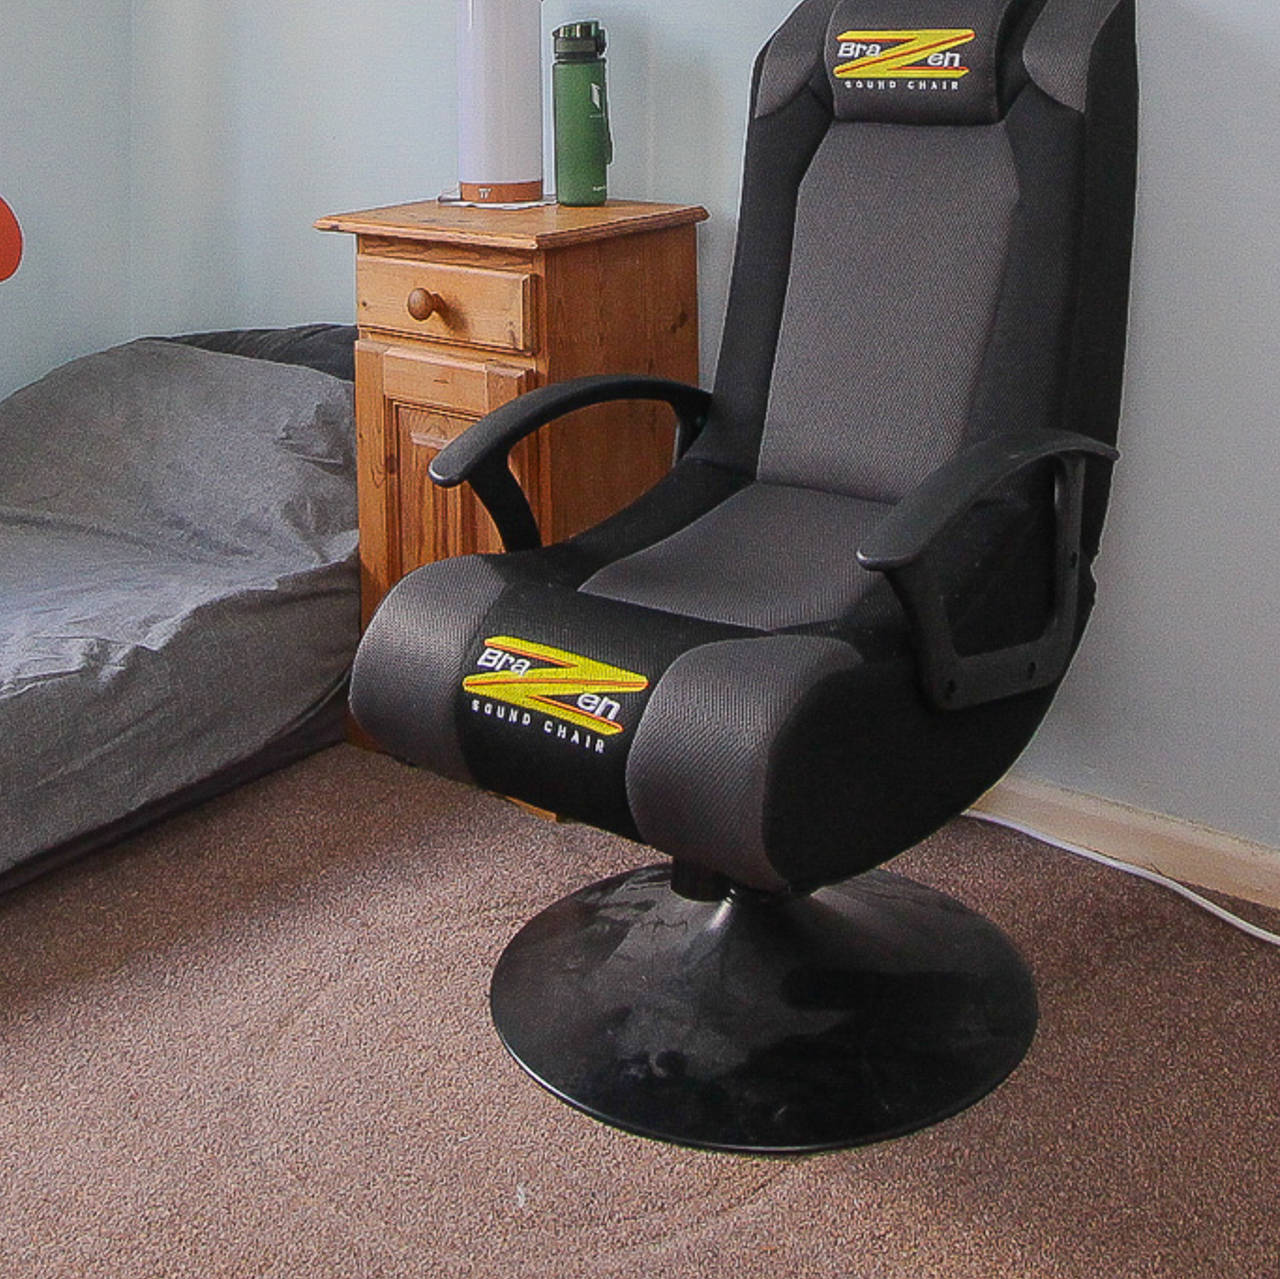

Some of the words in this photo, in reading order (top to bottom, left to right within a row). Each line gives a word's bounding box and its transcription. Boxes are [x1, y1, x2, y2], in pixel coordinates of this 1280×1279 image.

[844, 80, 897, 90] SOUND
[907, 80, 959, 91] CHAIR
[471, 699, 531, 726] SOUND
[543, 720, 606, 754] CHAIR
